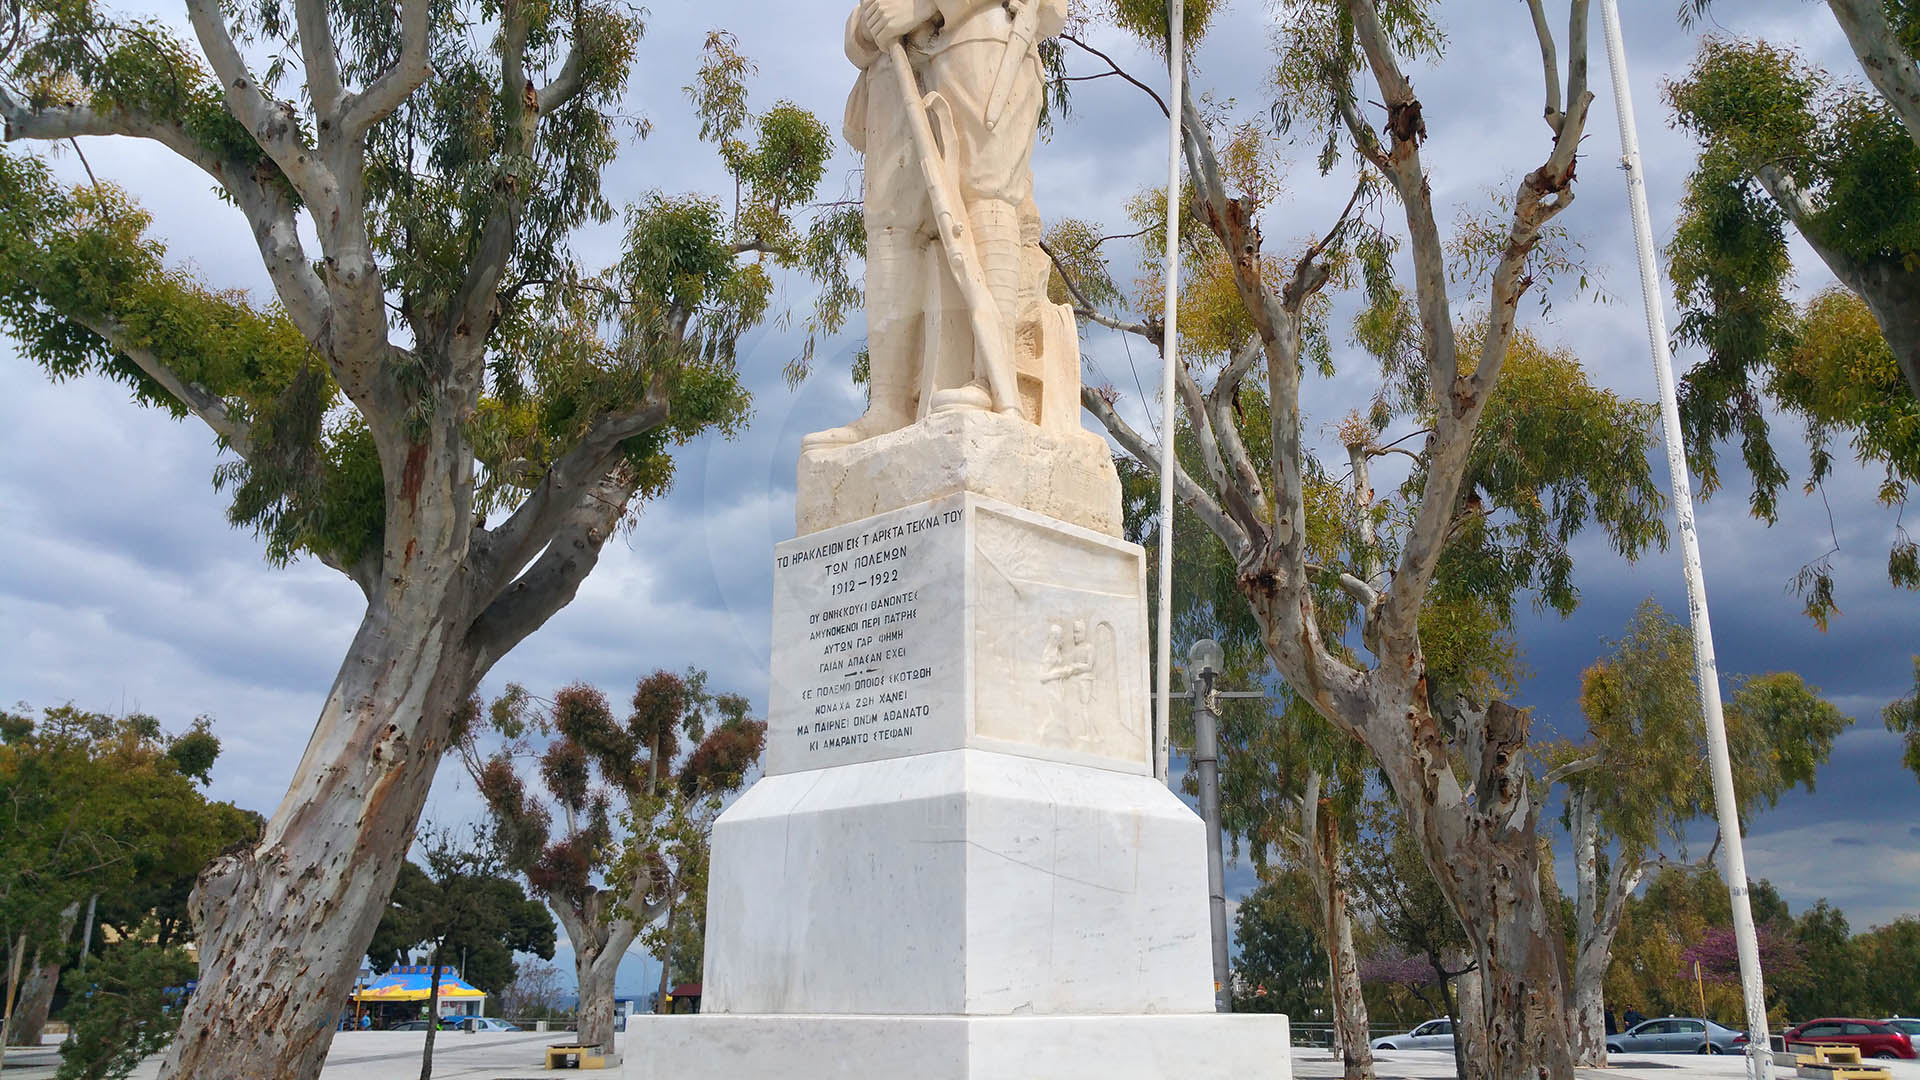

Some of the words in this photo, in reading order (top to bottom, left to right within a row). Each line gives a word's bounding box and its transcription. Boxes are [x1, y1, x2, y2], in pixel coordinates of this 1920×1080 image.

[777, 556, 789, 568] ΤΟ
[792, 541, 844, 565] ΗΡΑΚΛΕΙΟΝ
[846, 536, 860, 550] ΕΙΣ
[862, 534, 869, 546] Τ
[872, 525, 904, 544] ΑΡΙΣΤΑ
[905, 515, 940, 534] ΤΕΚΝΑ
[943, 509, 963, 524] ΤΟΥ
[825, 561, 848, 577] ΤΩΝ
[854, 545, 907, 570] ΠΟΛΕΜΩΝ
[809, 613, 820, 625] ΟΥ
[861, 617, 880, 629] ΠΕΡΙ
[824, 640, 853, 655] ΑΥΤΩΝ
[856, 636, 873, 648] ΓΑΡ
[819, 660, 843, 673] ΓΑΙΑΝ
[886, 647, 906, 660] ΕΧΕΙ
[855, 696, 875, 708] ΖΩΗ
[879, 690, 908, 704] ΧΑΝΕΙ
[797, 724, 809, 736] ΜΑ
[814, 718, 849, 733] ΠΑΙΡΝΕΙ
[883, 704, 930, 721] ΑΘΑΝΑΤΟ
[809, 741, 819, 751] ΚΙ
[823, 733, 869, 749] ΑΜΑΡΑΝΤΟ
